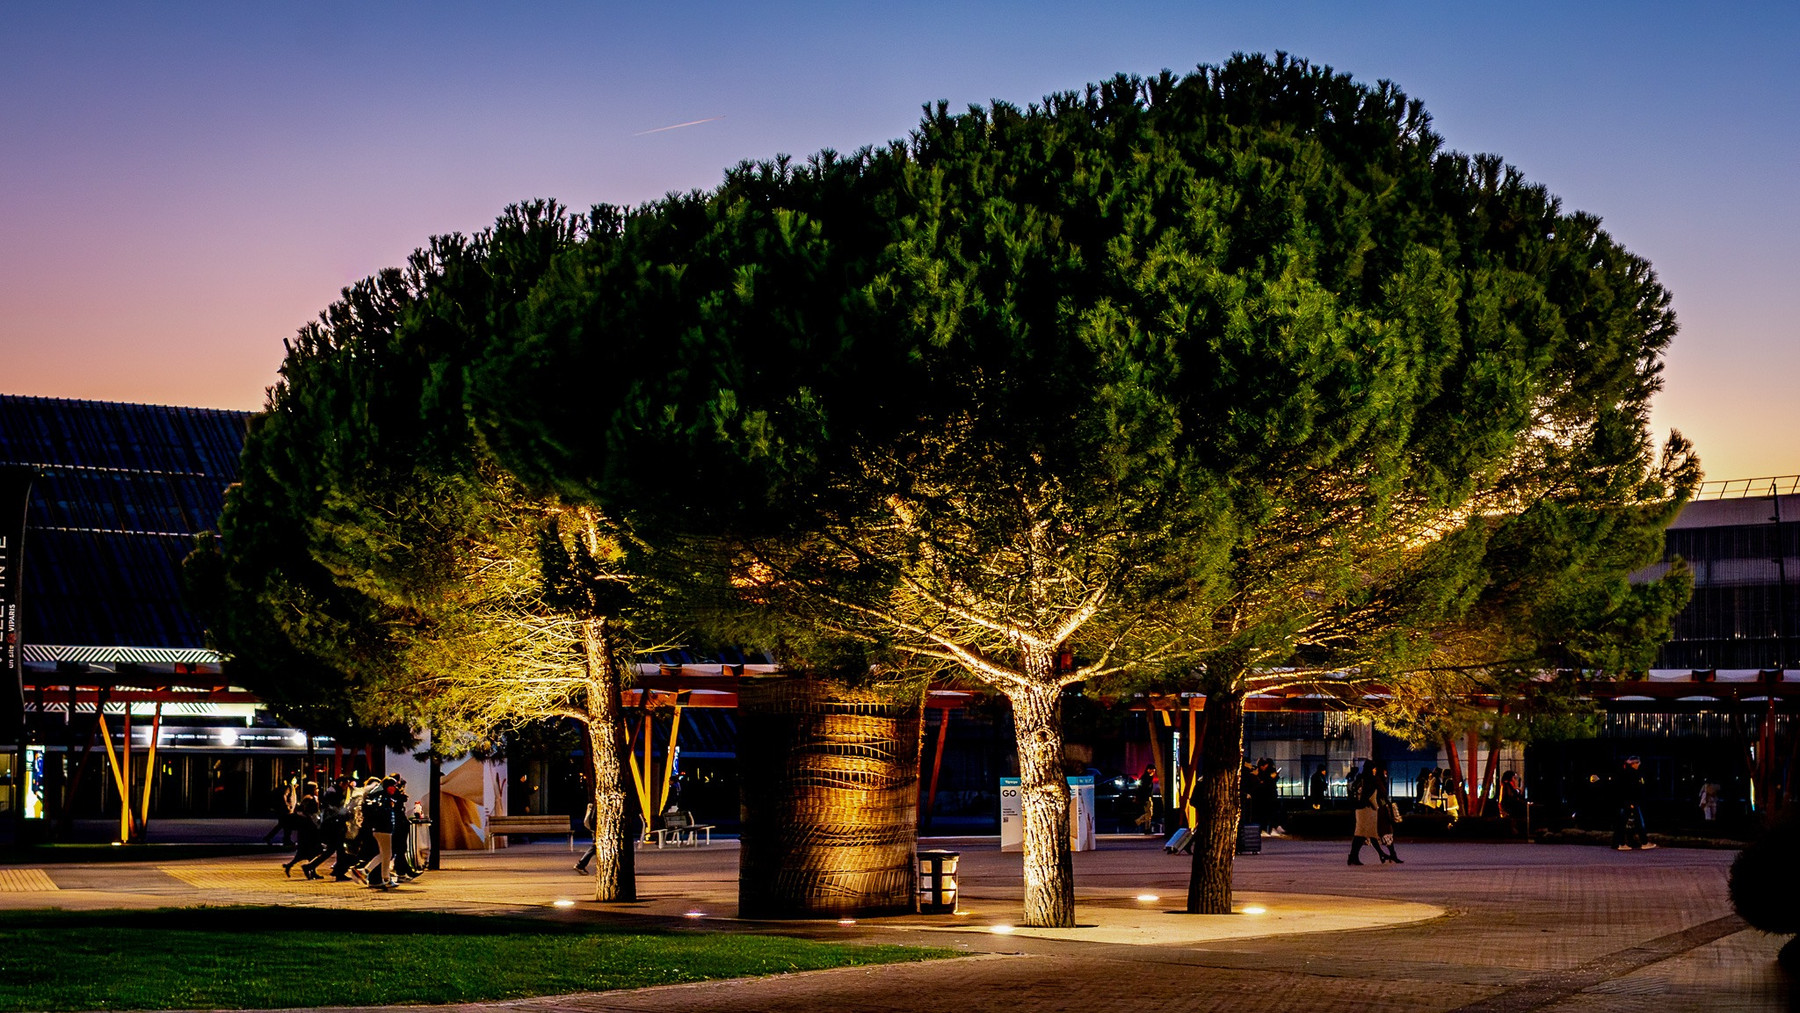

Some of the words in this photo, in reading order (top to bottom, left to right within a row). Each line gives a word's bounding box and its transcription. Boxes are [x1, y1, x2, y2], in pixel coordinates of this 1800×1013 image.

[8, 603, 16, 632] VIPARIS
[9, 659, 14, 669] un
[1002, 789, 1017, 797] GO
